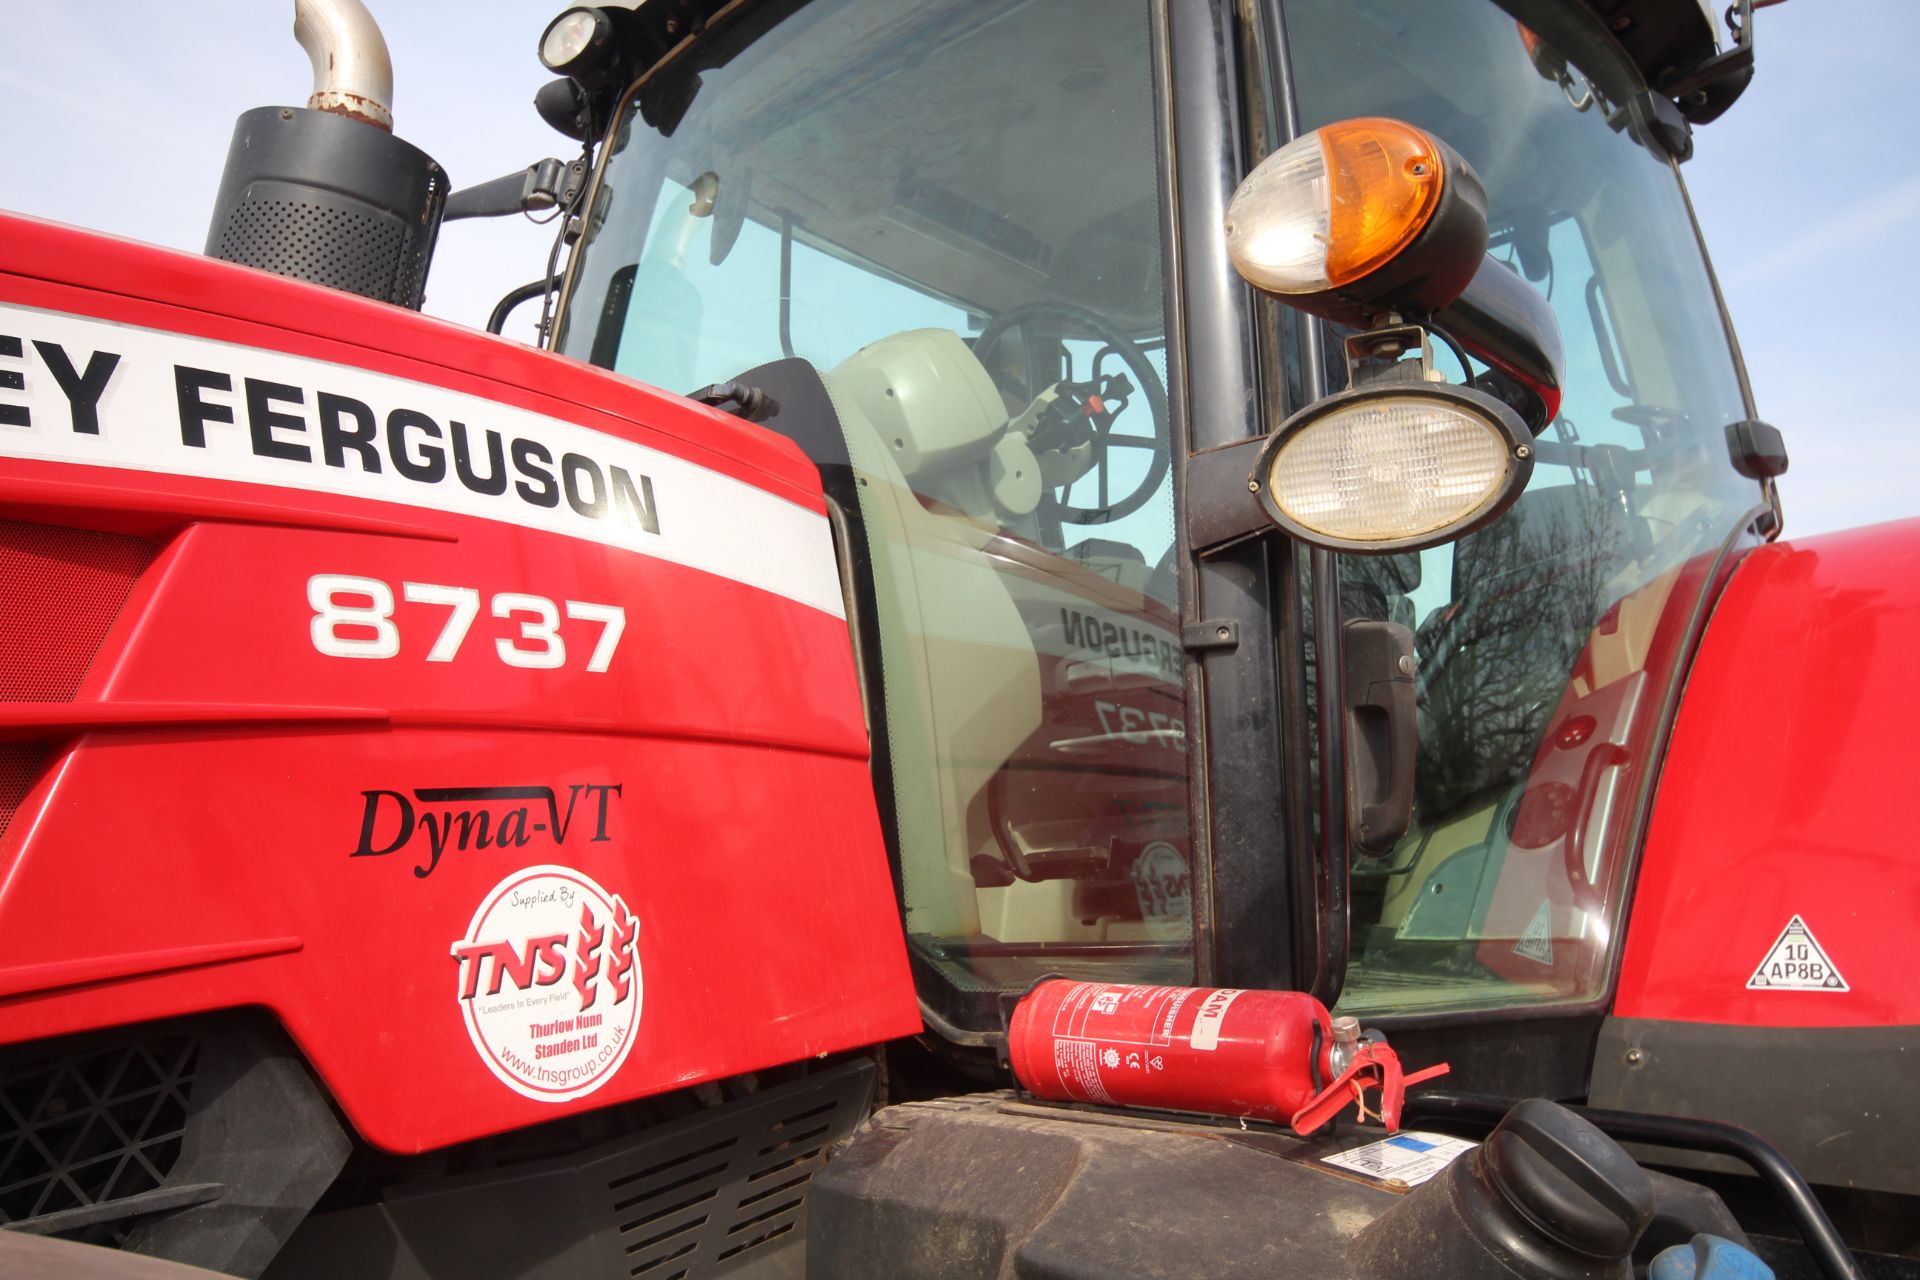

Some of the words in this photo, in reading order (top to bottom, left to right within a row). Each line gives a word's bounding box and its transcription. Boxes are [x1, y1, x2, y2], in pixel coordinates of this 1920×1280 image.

[174, 364, 661, 536] FERGUSON
[306, 573, 626, 674] 8737
[349, 782, 623, 878] Dyna-VT
[511, 888, 556, 909] Supplied
[559, 886, 576, 909] By
[457, 932, 569, 1000] TNS
[1785, 944, 1808, 961] 10
[1771, 962, 1823, 980] AP8B
[517, 999, 525, 1010] In
[526, 995, 548, 1009] Every
[530, 1019, 574, 1039] Thurlow
[576, 1013, 603, 1030] Nunn
[501, 1024, 626, 1087] www.tnsgroup.co.uk
[535, 1038, 580, 1060] Standen
[582, 1033, 598, 1049] Ltd
